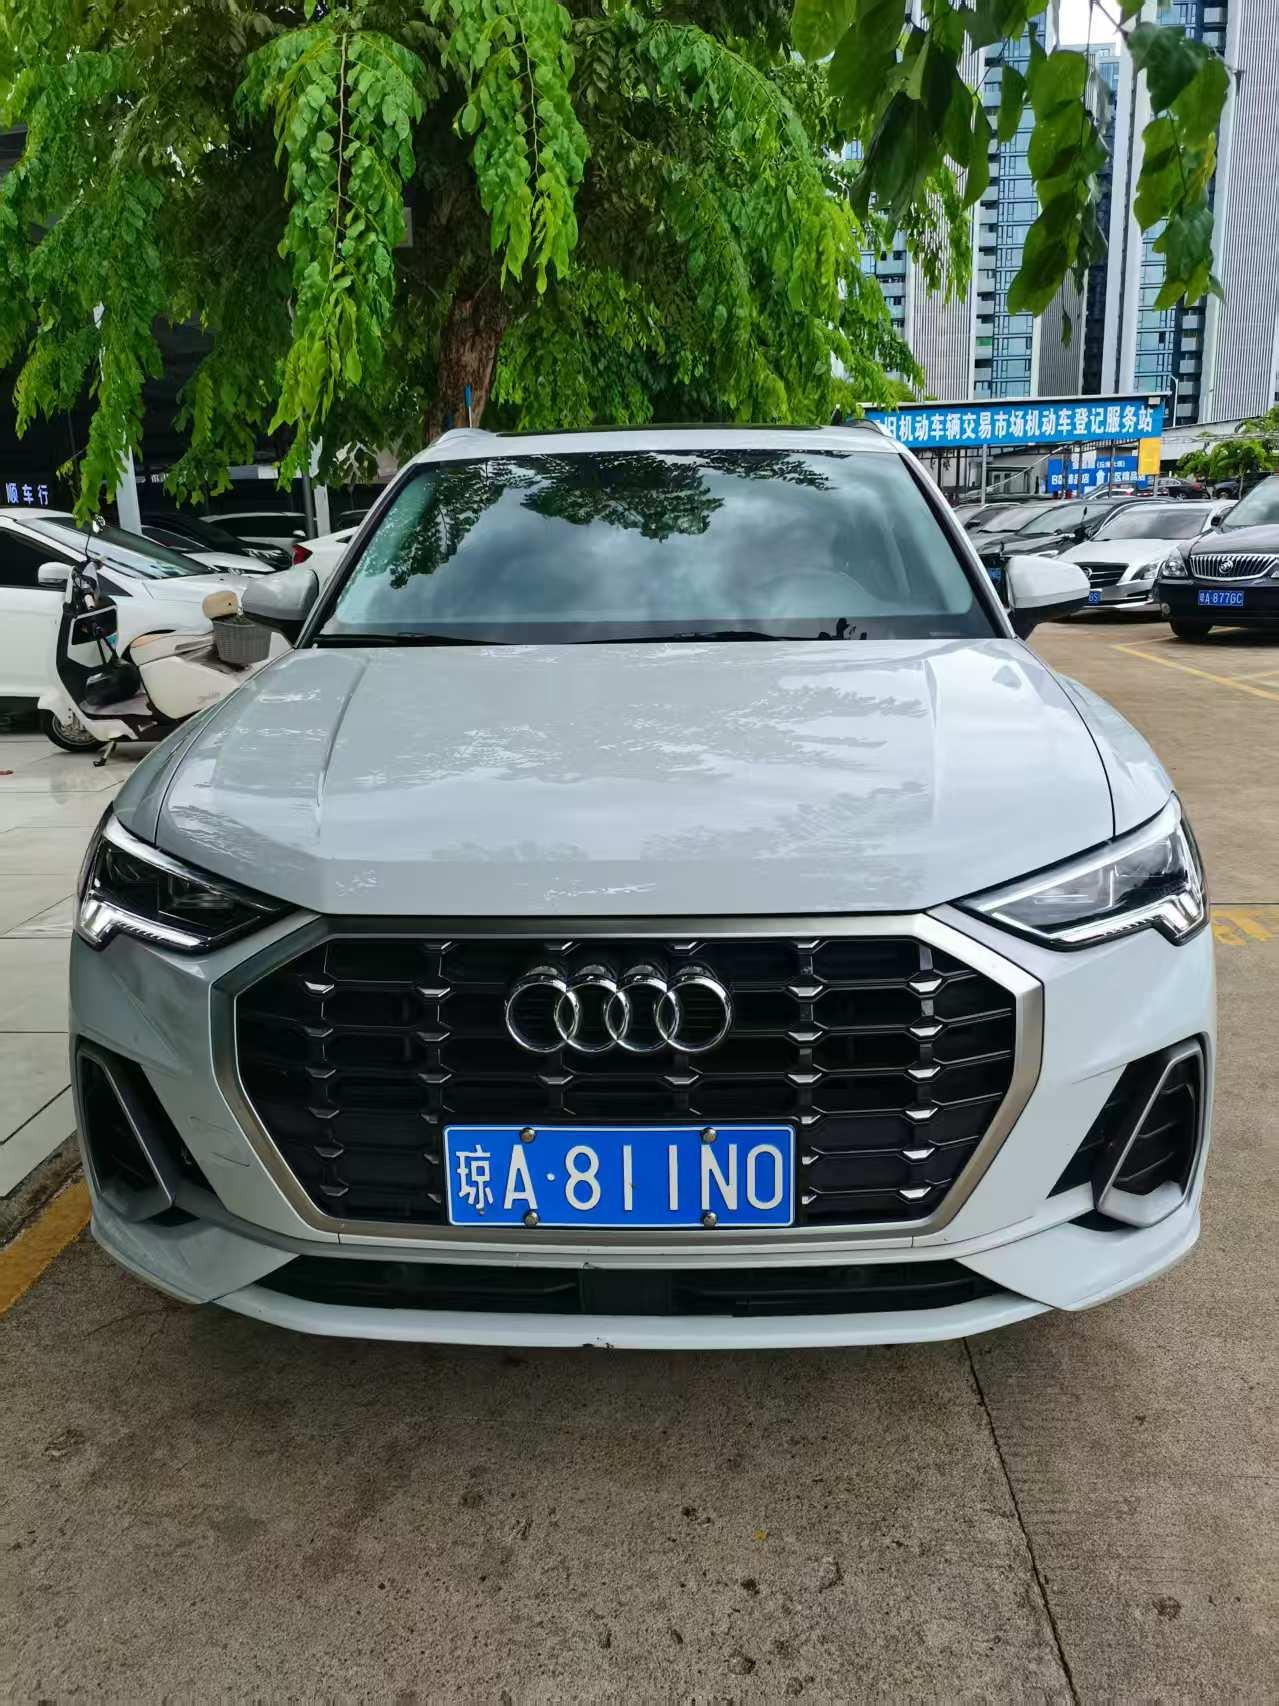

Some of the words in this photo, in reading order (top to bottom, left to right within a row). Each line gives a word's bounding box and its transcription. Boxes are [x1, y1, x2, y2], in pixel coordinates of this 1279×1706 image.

[874, 406, 1154, 441] 旧机动车辆交易市场机动车登记服务站
